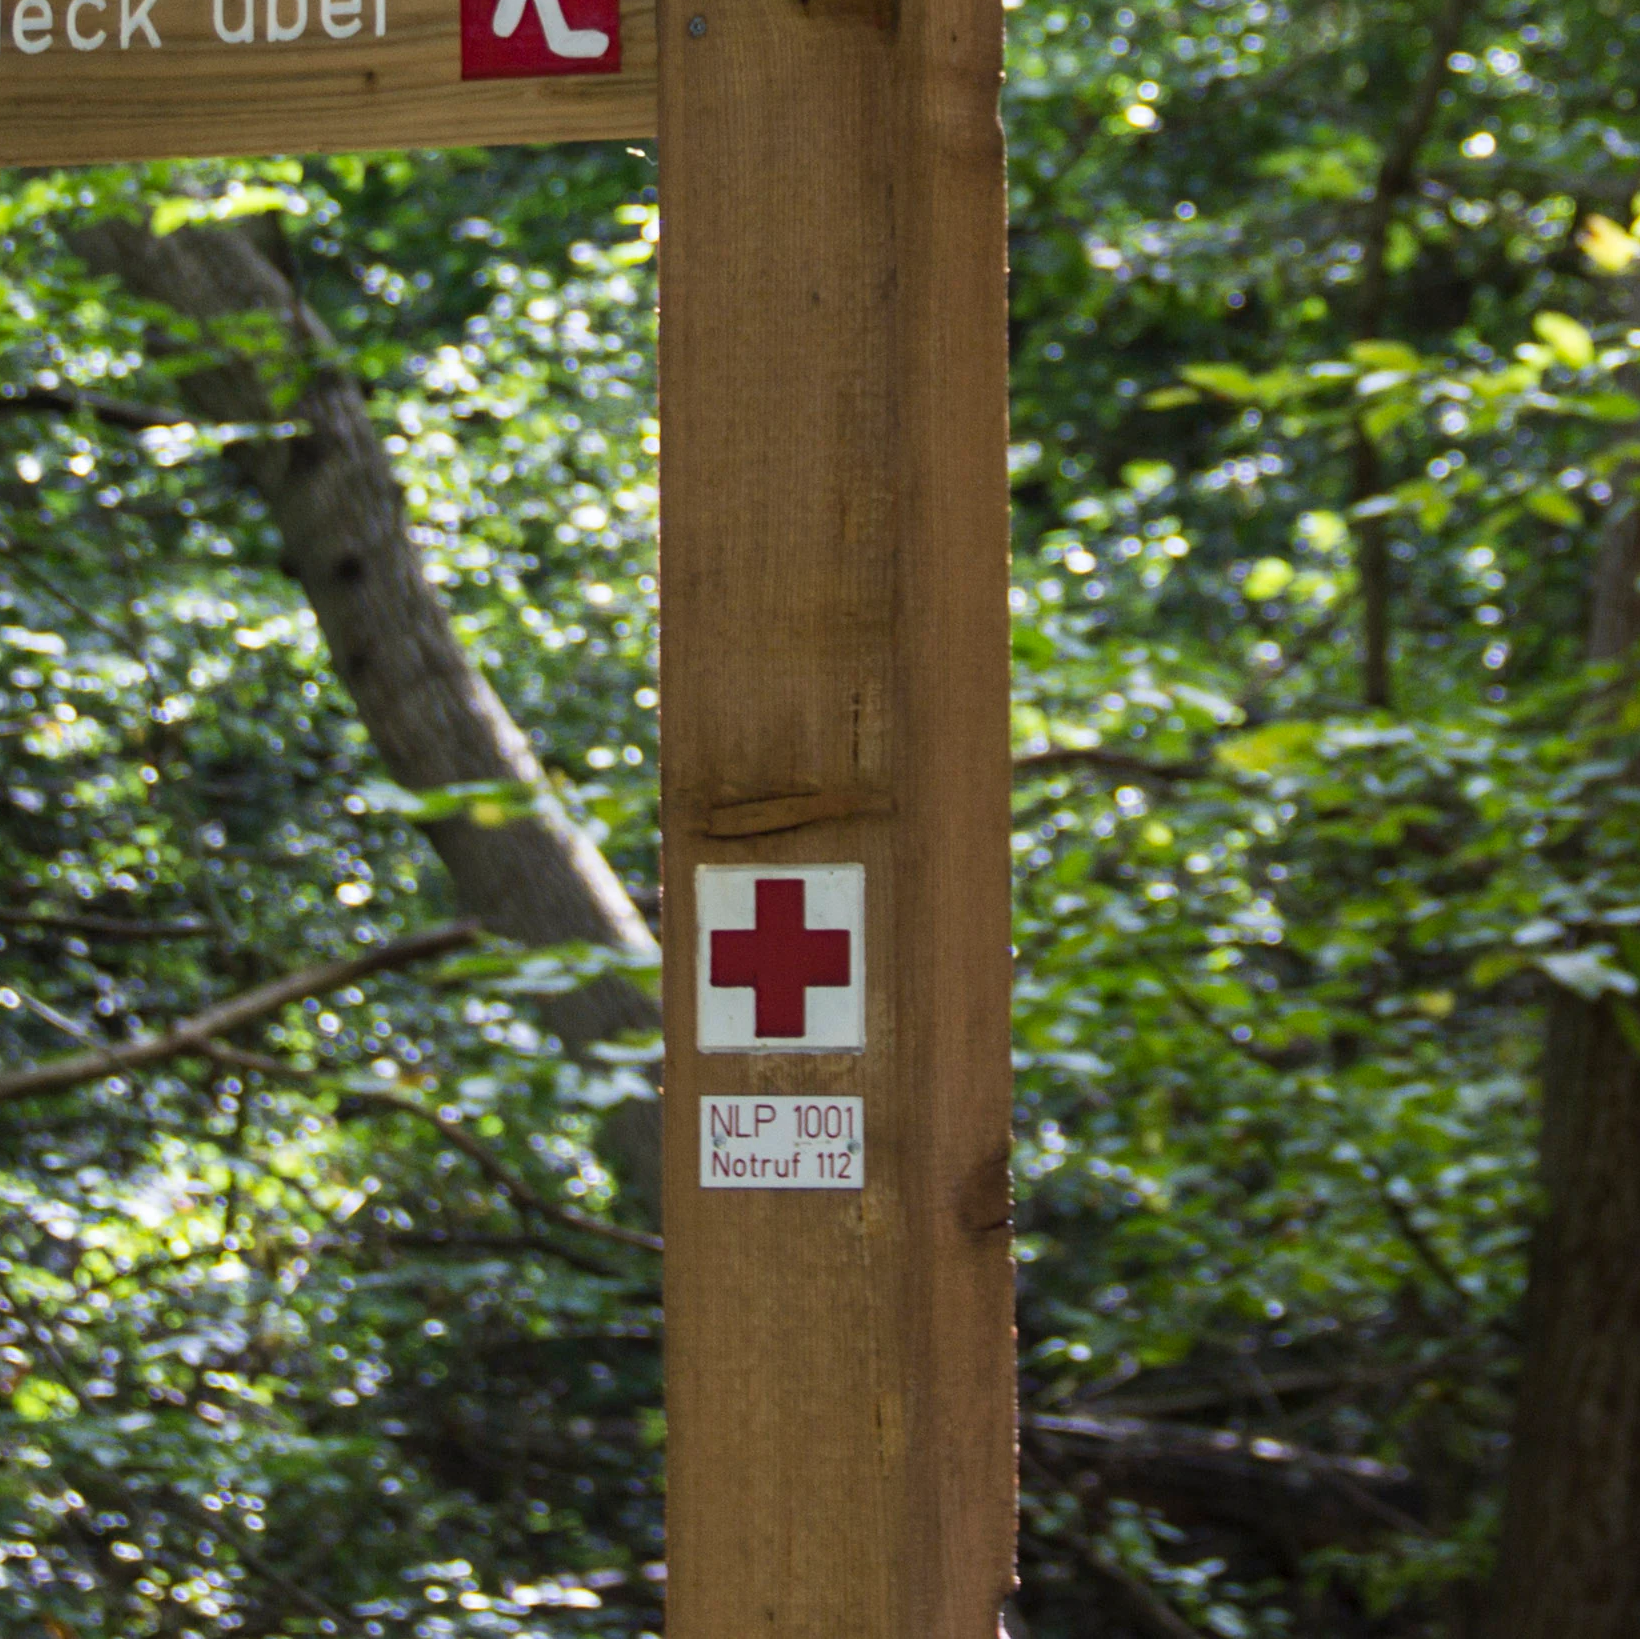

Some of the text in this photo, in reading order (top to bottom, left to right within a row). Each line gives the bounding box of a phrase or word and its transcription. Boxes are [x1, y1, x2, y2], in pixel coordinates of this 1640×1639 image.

[710, 1104, 854, 1139] NLP 1001
[712, 1151, 852, 1179] Notruf 112
